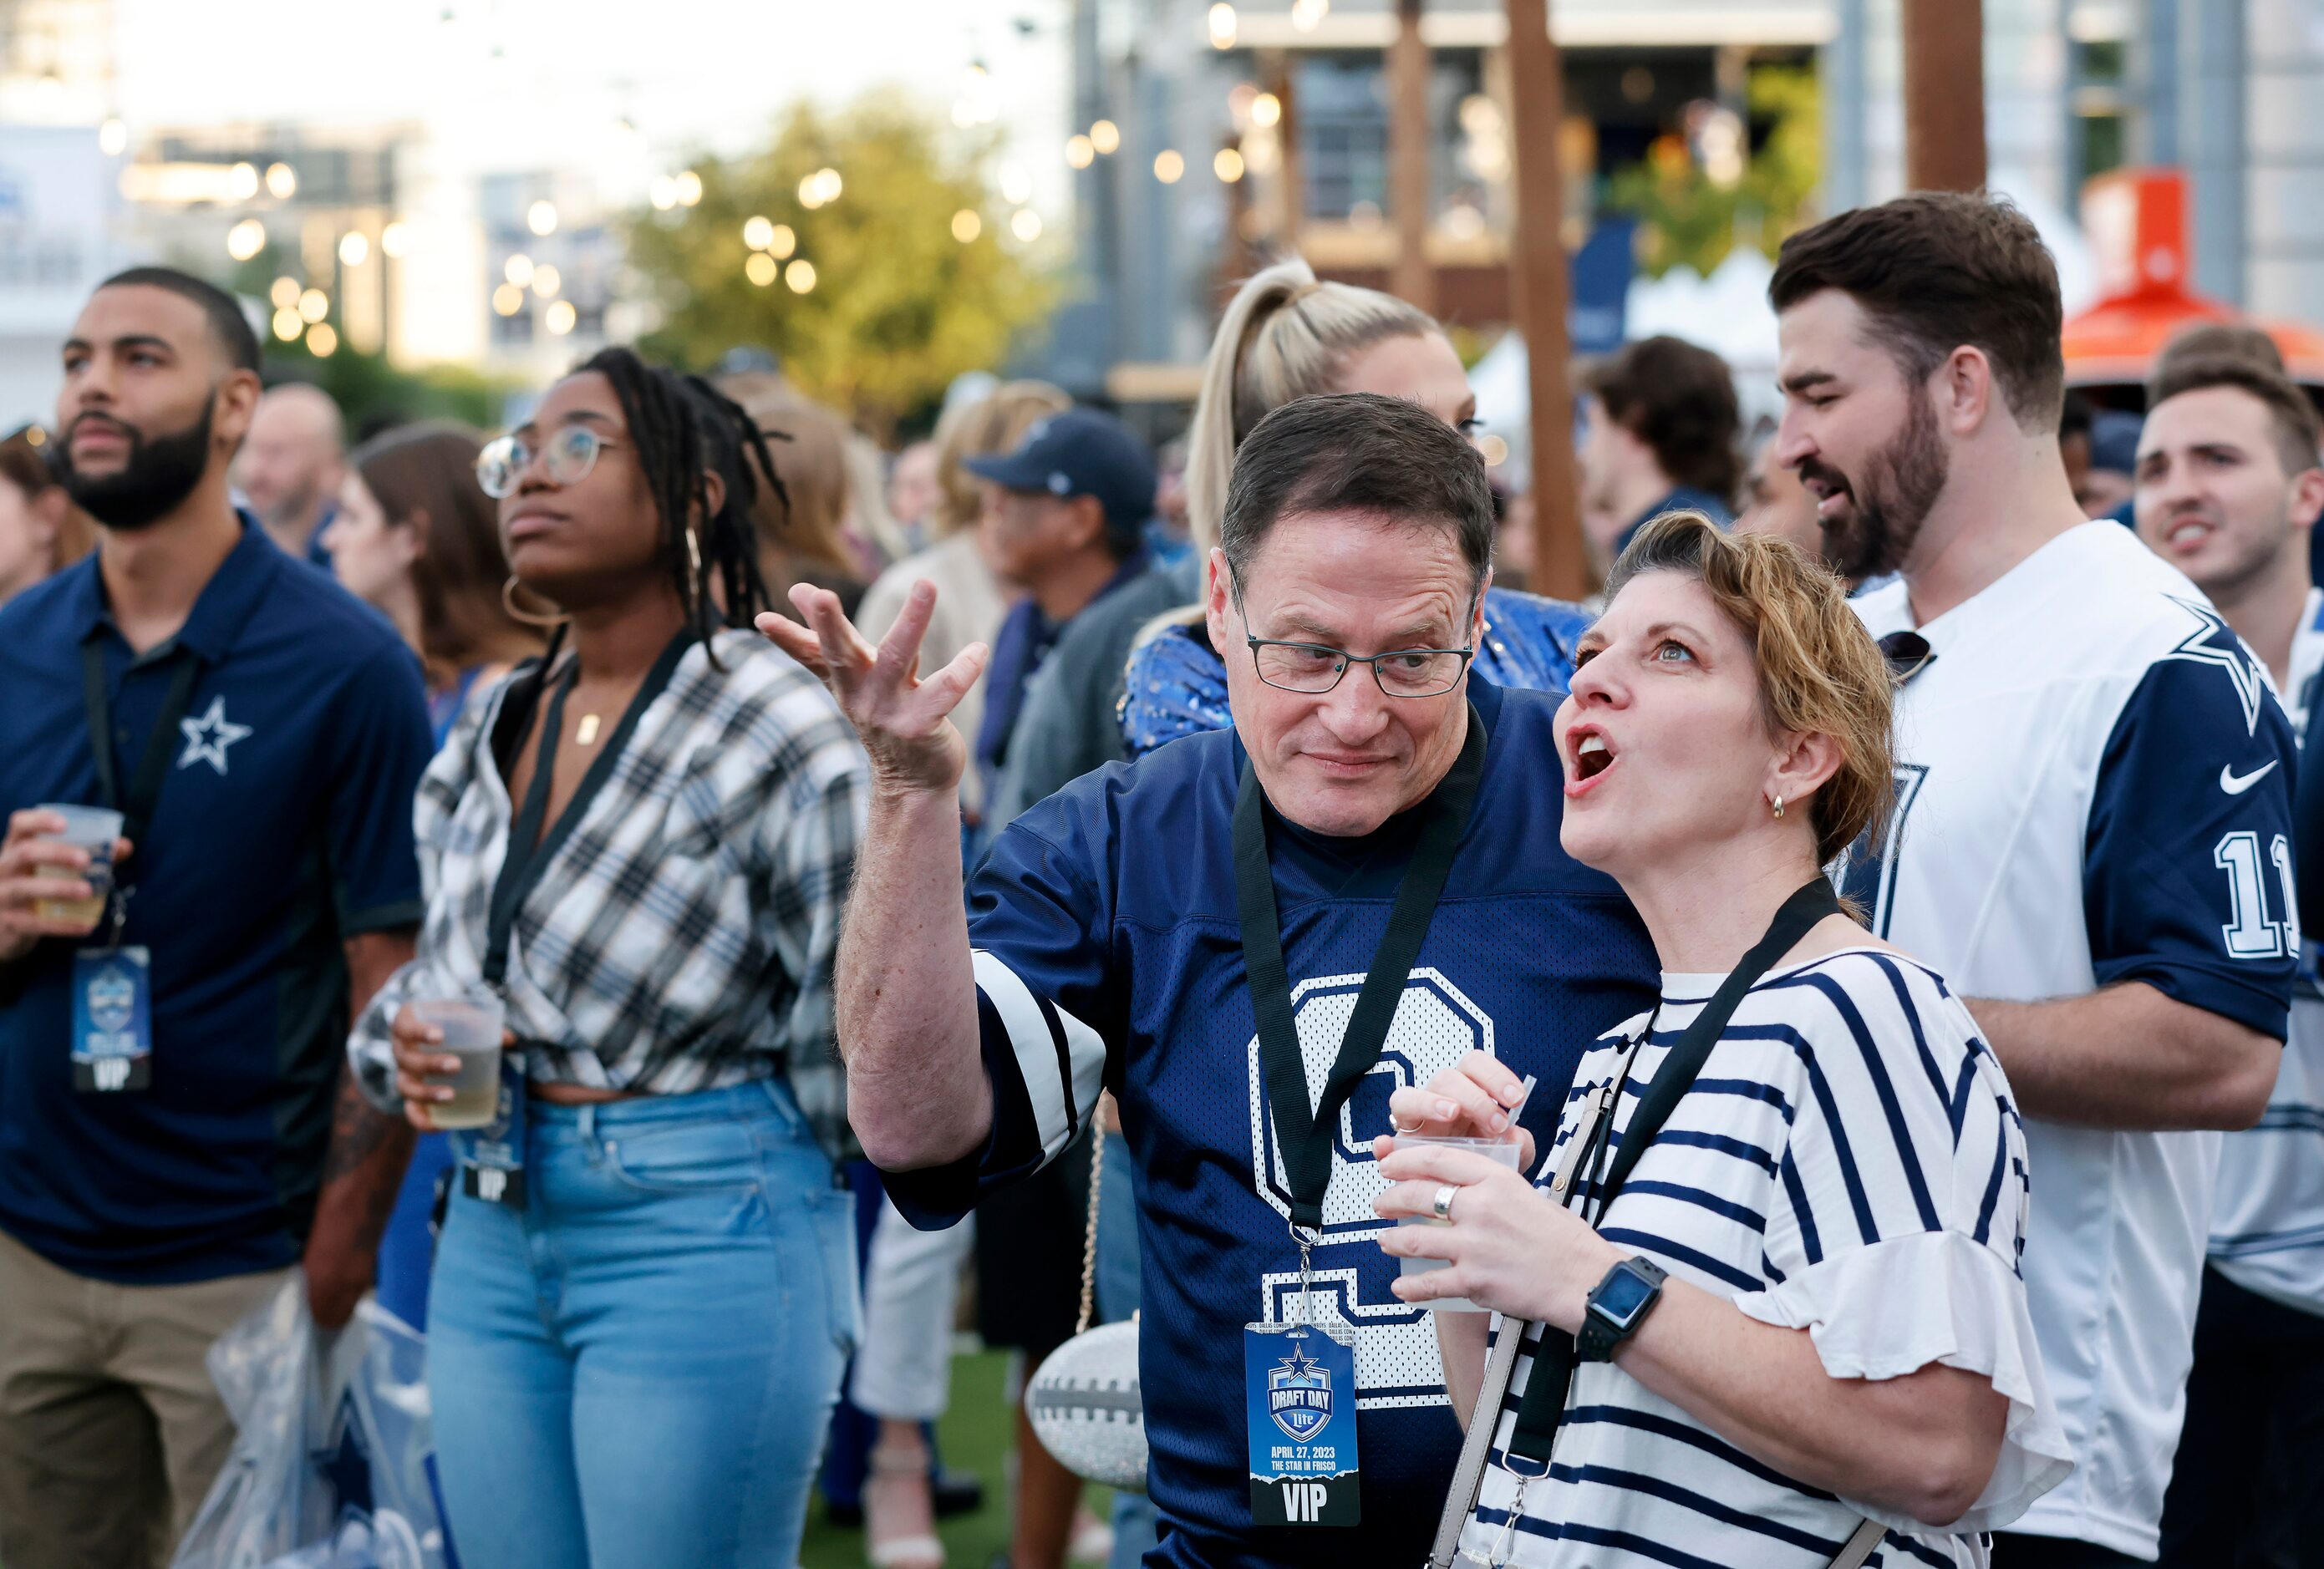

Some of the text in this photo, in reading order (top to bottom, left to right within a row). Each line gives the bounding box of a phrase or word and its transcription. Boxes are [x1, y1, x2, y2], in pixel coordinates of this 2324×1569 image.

[2214, 830, 2300, 960] 11
[1272, 1390, 1330, 1410] DRAFT DAY
[1291, 1413, 1314, 1428] Lite
[1271, 1446, 1335, 1460] APRIL 27, 2023
[1271, 1460, 1336, 1470] THE STAR IN FRISCO
[1282, 1483, 1328, 1522] VIP
